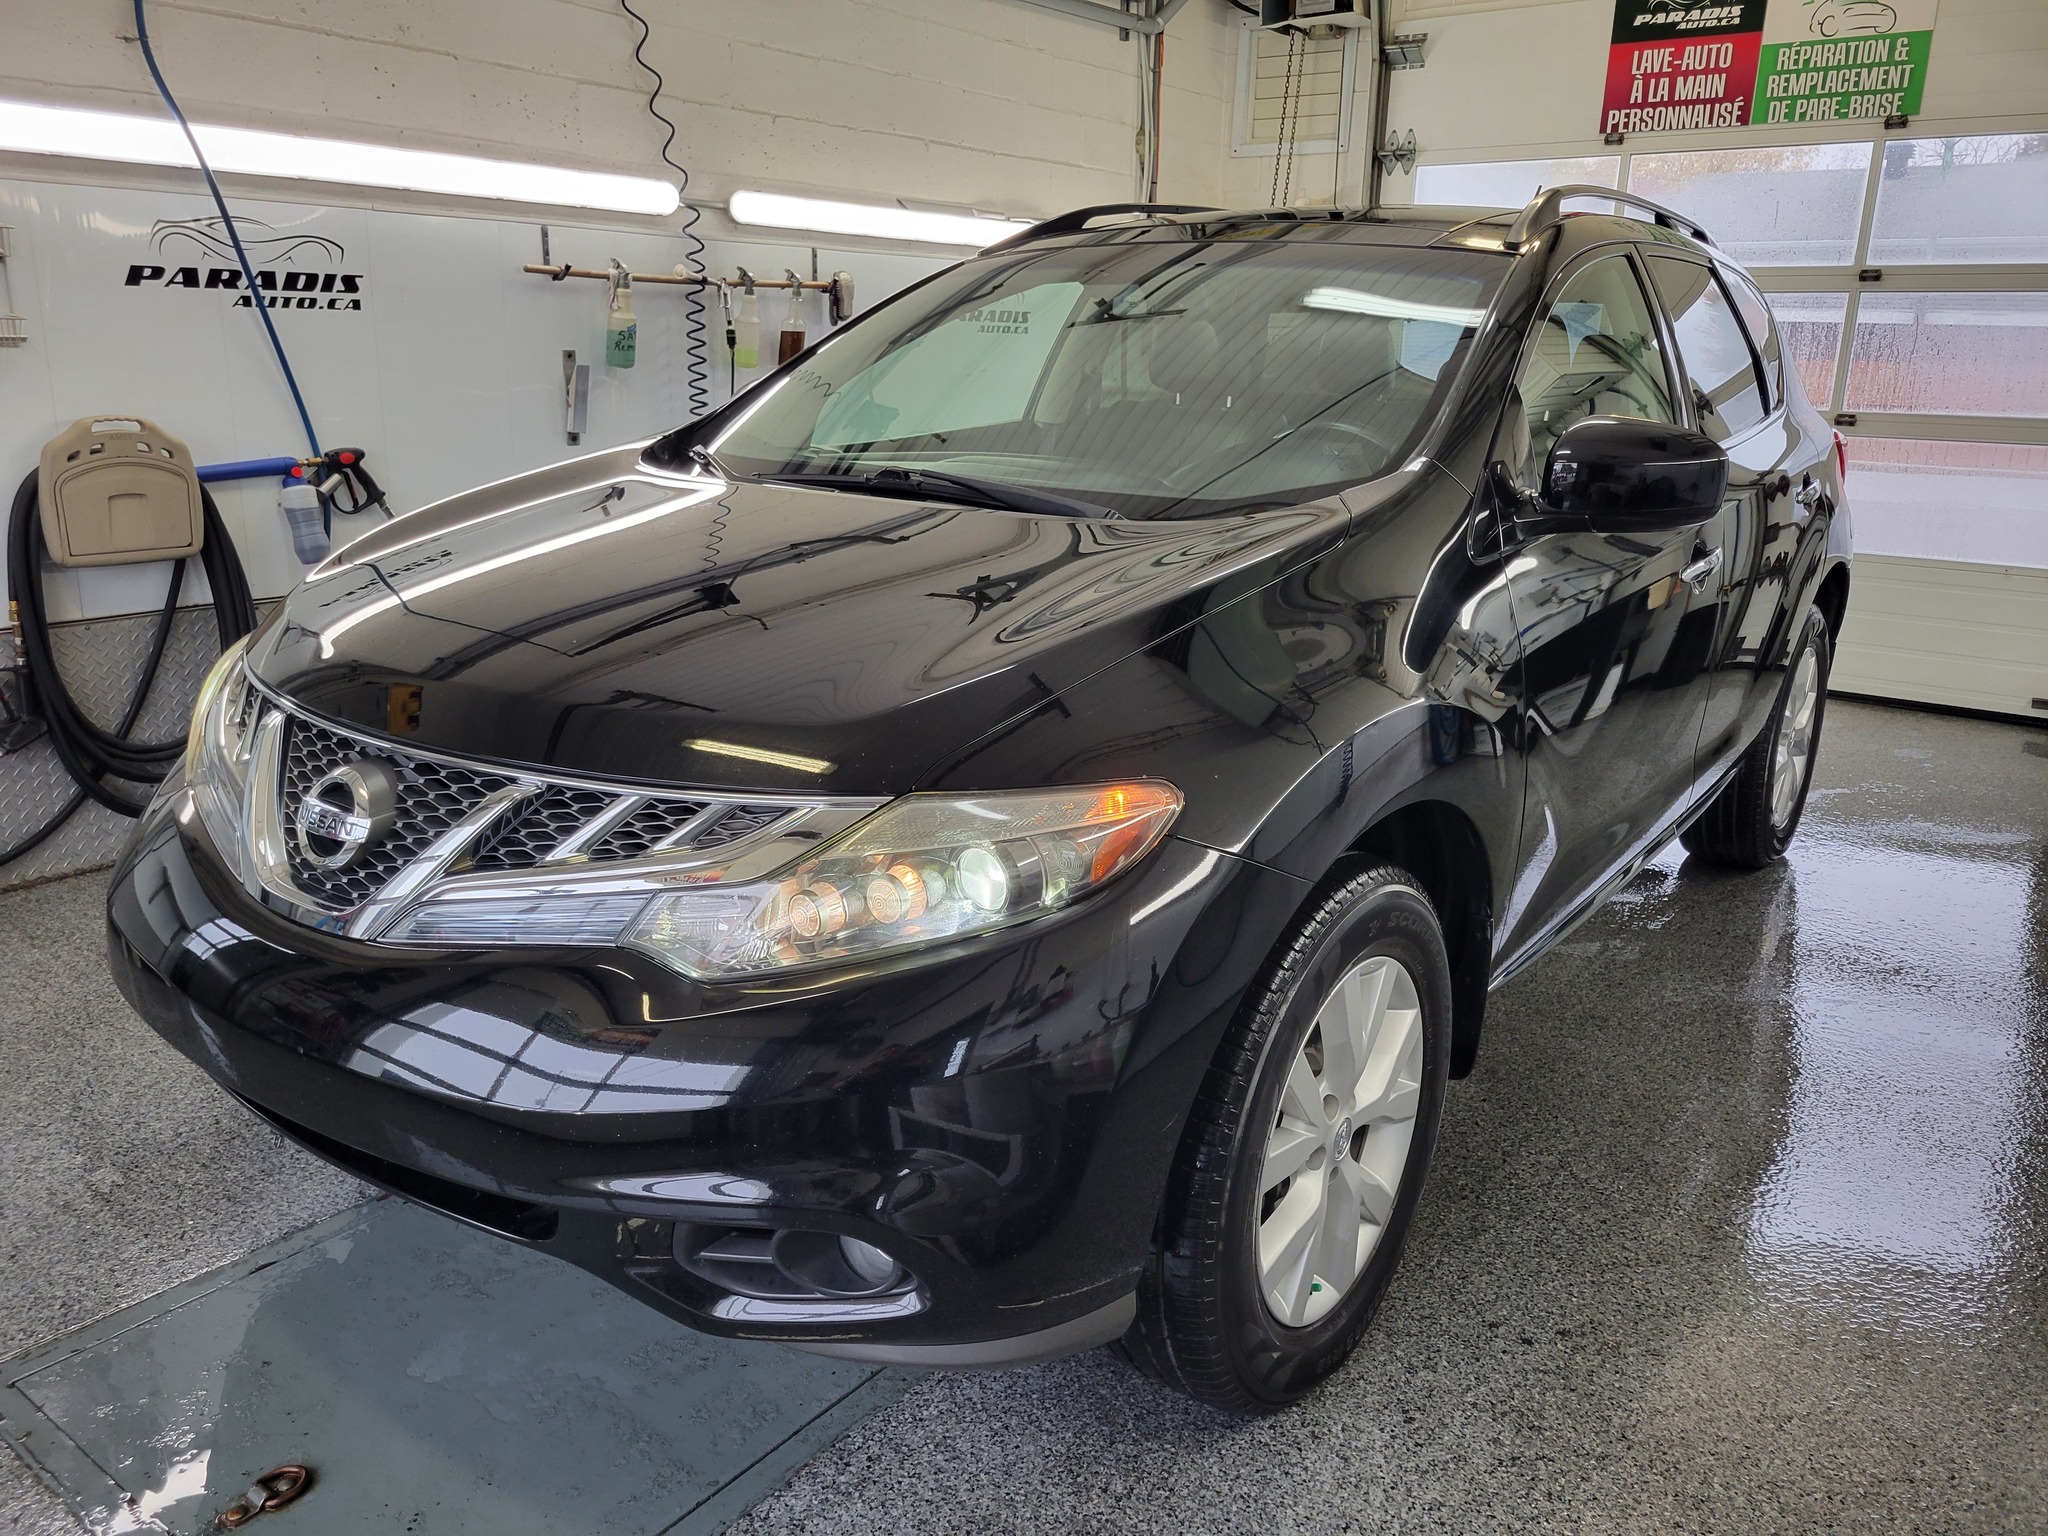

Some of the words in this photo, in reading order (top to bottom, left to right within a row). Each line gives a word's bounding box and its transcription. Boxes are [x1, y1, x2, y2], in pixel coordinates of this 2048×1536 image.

[1632, 5, 1745, 27] PARADIS
[1676, 17, 1741, 31] AUTO.CA
[1631, 42, 1734, 75] LAVE-AUTO
[1776, 38, 1890, 71] RÉPARATION
[1894, 37, 1910, 62] &
[1630, 75, 1643, 104] À
[1648, 77, 1670, 103] LA
[1674, 73, 1727, 101] MAIN
[1766, 64, 1914, 98] REMPLACEMENT
[1606, 96, 1745, 134] PERSONNALISÉ
[1767, 100, 1791, 124] DE
[1794, 92, 1904, 122] PARE-BRISE
[124, 264, 364, 294] PARADIS
[232, 295, 362, 311] AUTO.CA
[301, 803, 355, 837] NISSAN
